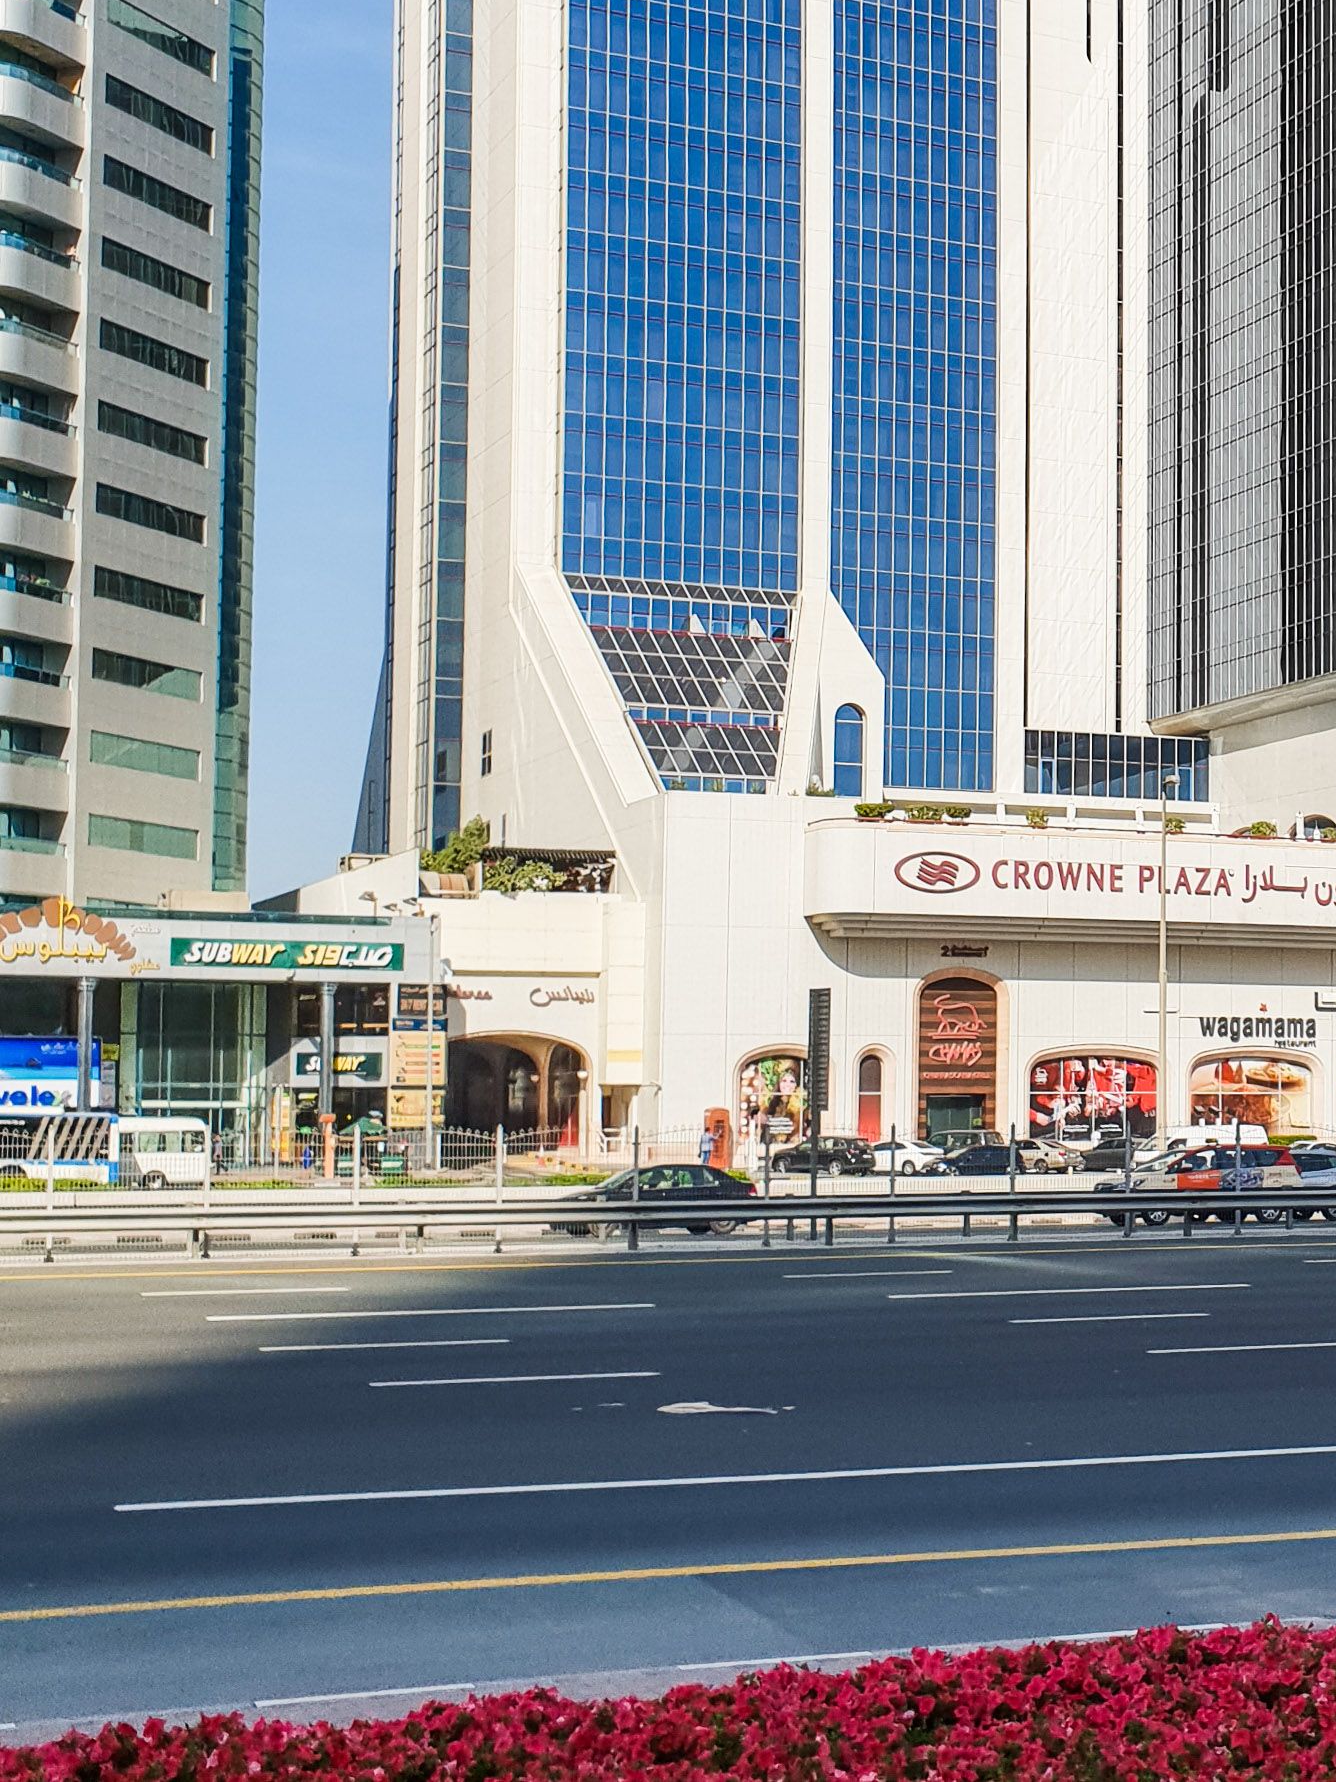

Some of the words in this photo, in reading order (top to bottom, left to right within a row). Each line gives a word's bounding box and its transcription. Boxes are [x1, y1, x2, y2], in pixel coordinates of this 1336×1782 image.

[992, 859, 1124, 893] CROWNE
[1138, 864, 1232, 897] PLAZA
[184, 942, 284, 964] SUBWAY
[1200, 1016, 1316, 1043] wagamama
